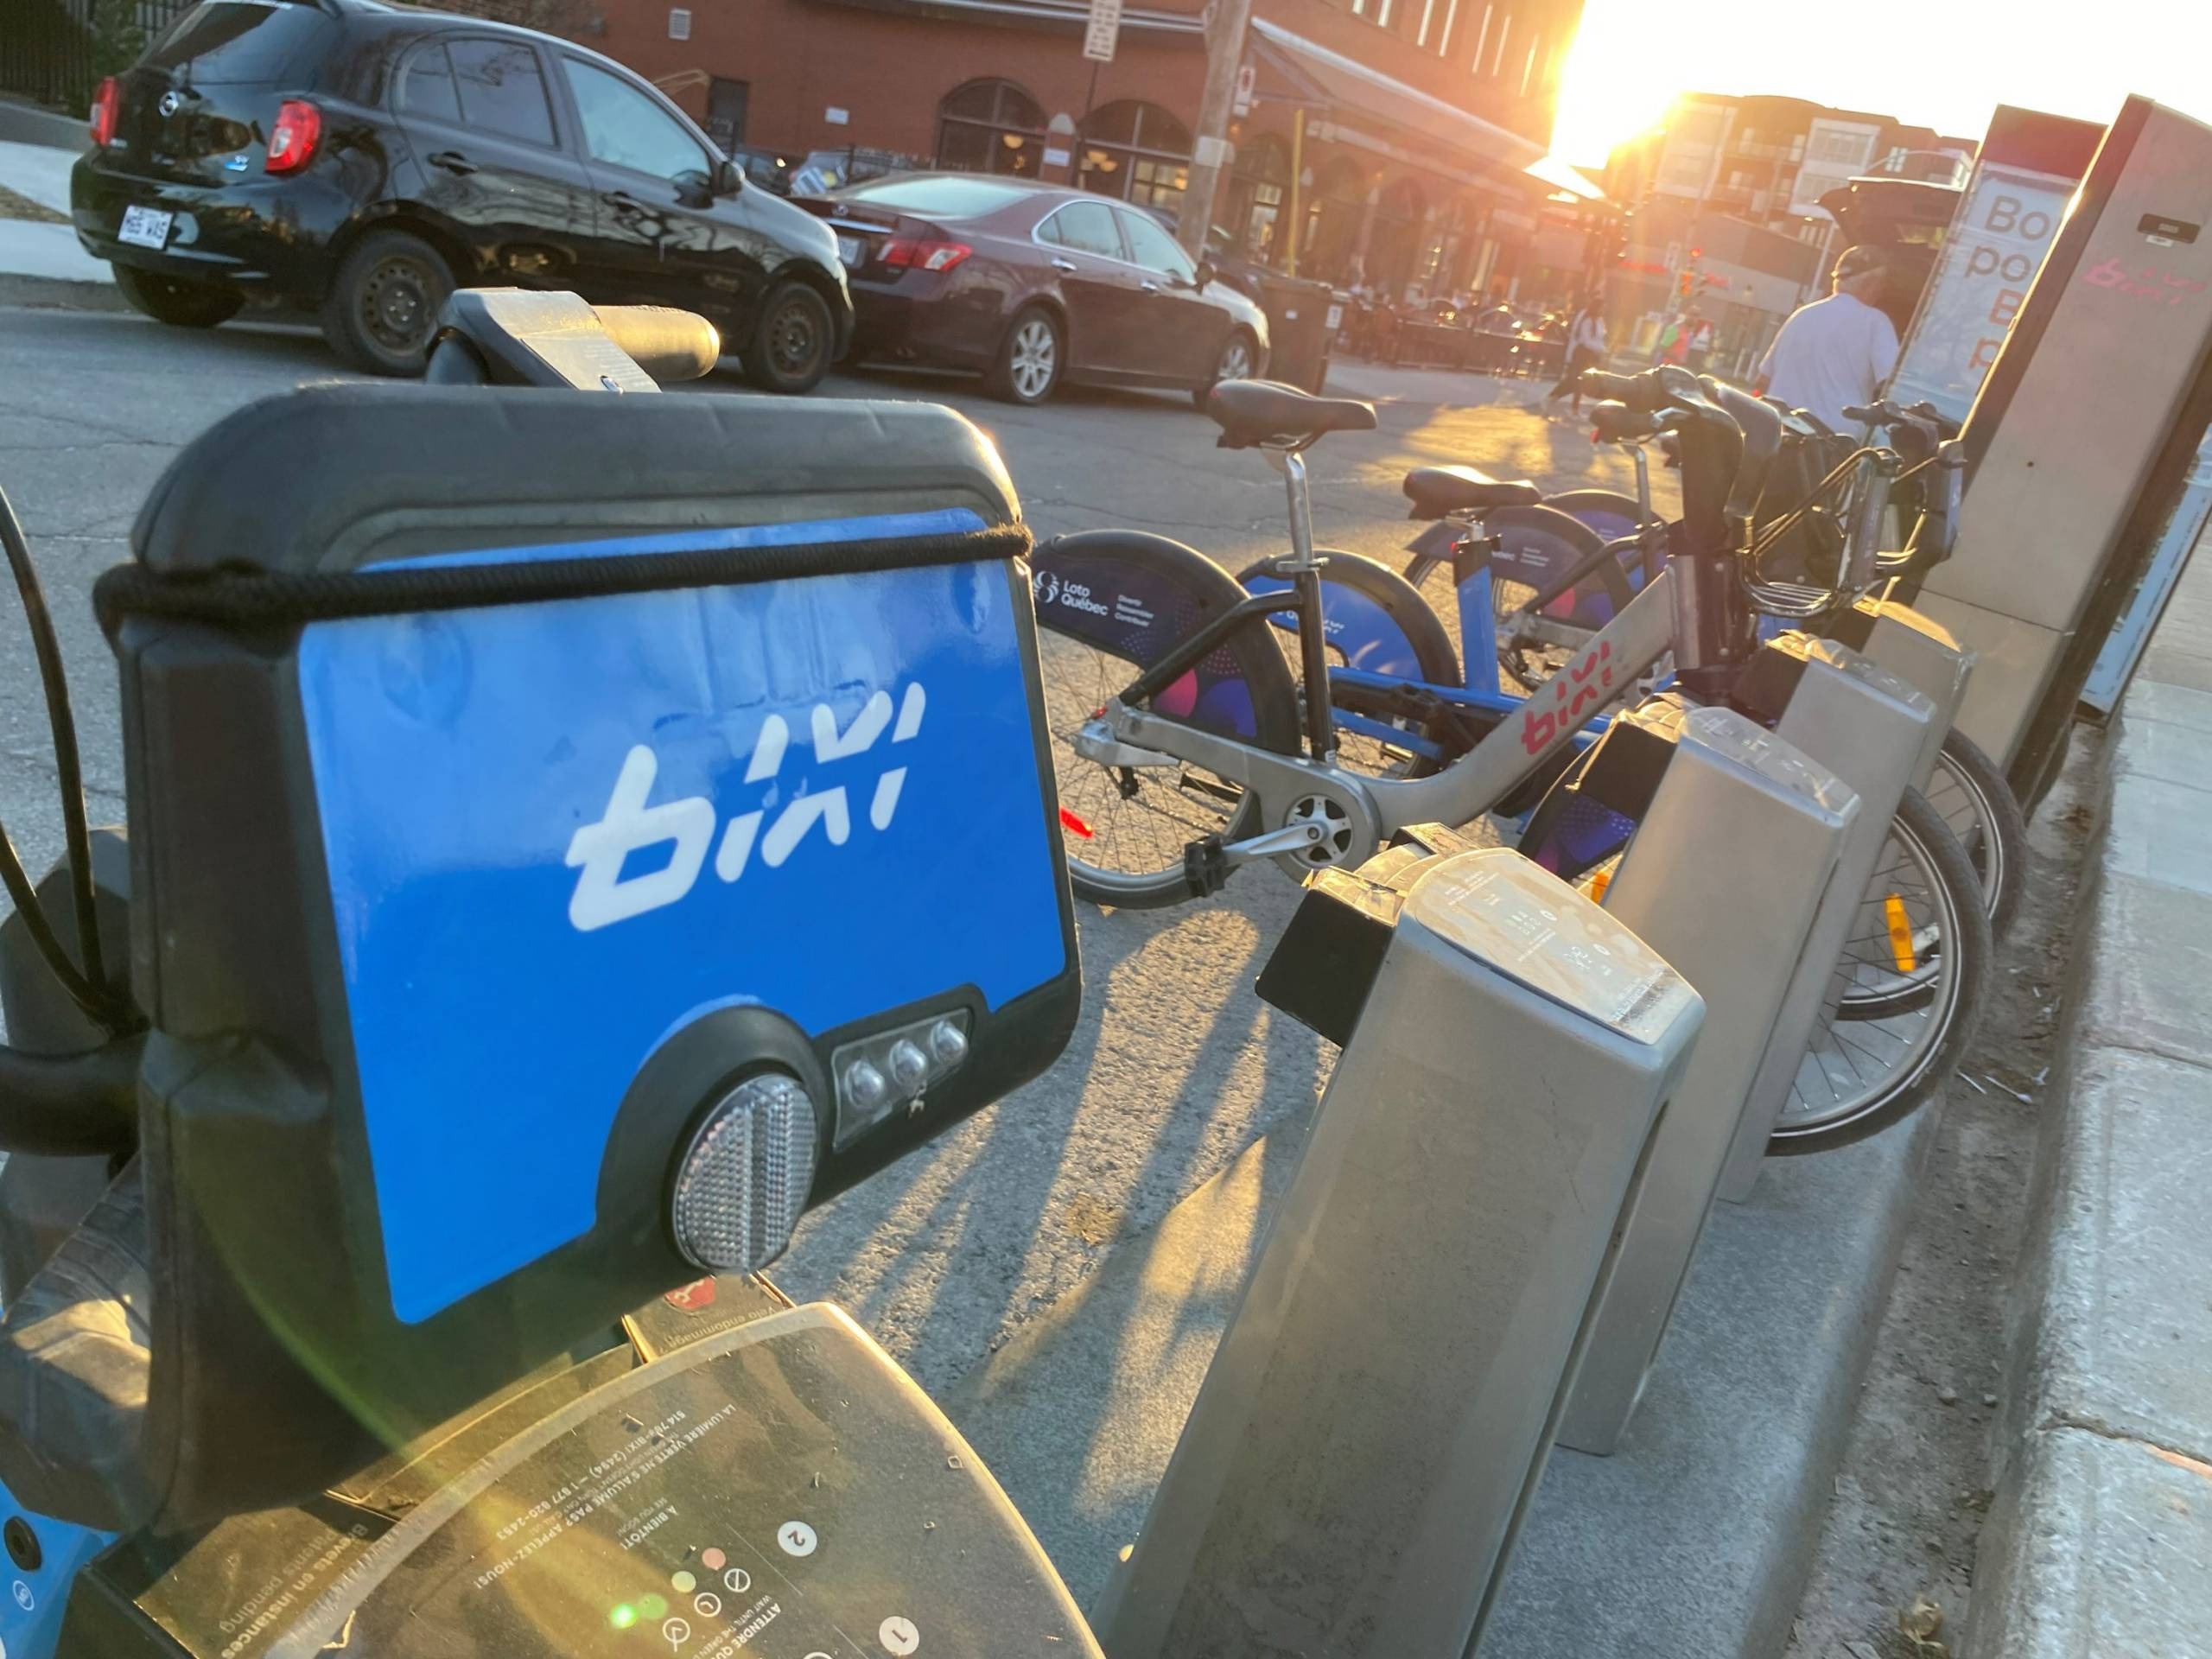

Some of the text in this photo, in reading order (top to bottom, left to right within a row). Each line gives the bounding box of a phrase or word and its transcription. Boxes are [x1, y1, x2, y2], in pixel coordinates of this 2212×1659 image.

[1985, 195, 2050, 241] Bo
[1964, 245, 2032, 283] po
[1063, 580, 1090, 597] Loto
[1061, 593, 1109, 616] Québec
[1521, 640, 1611, 755] bixi
[565, 682, 926, 931] bixi
[666, 1410, 686, 1426] 514
[721, 1403, 736, 1415] LA
[654, 1439, 687, 1464] VERTE
[639, 1458, 656, 1474] NE
[566, 1503, 594, 1527] PAS?
[788, 1529, 806, 1549] 2
[474, 1523, 563, 1589] APPELEZ-NOUS!
[221, 1523, 369, 1659] Brevets en instances
[753, 1594, 772, 1612] WAIT
[219, 1575, 283, 1633] pending
[733, 1609, 755, 1626] UNTIL
[710, 1603, 782, 1659] ATTENDRE QU
[891, 1629, 908, 1645] 1
